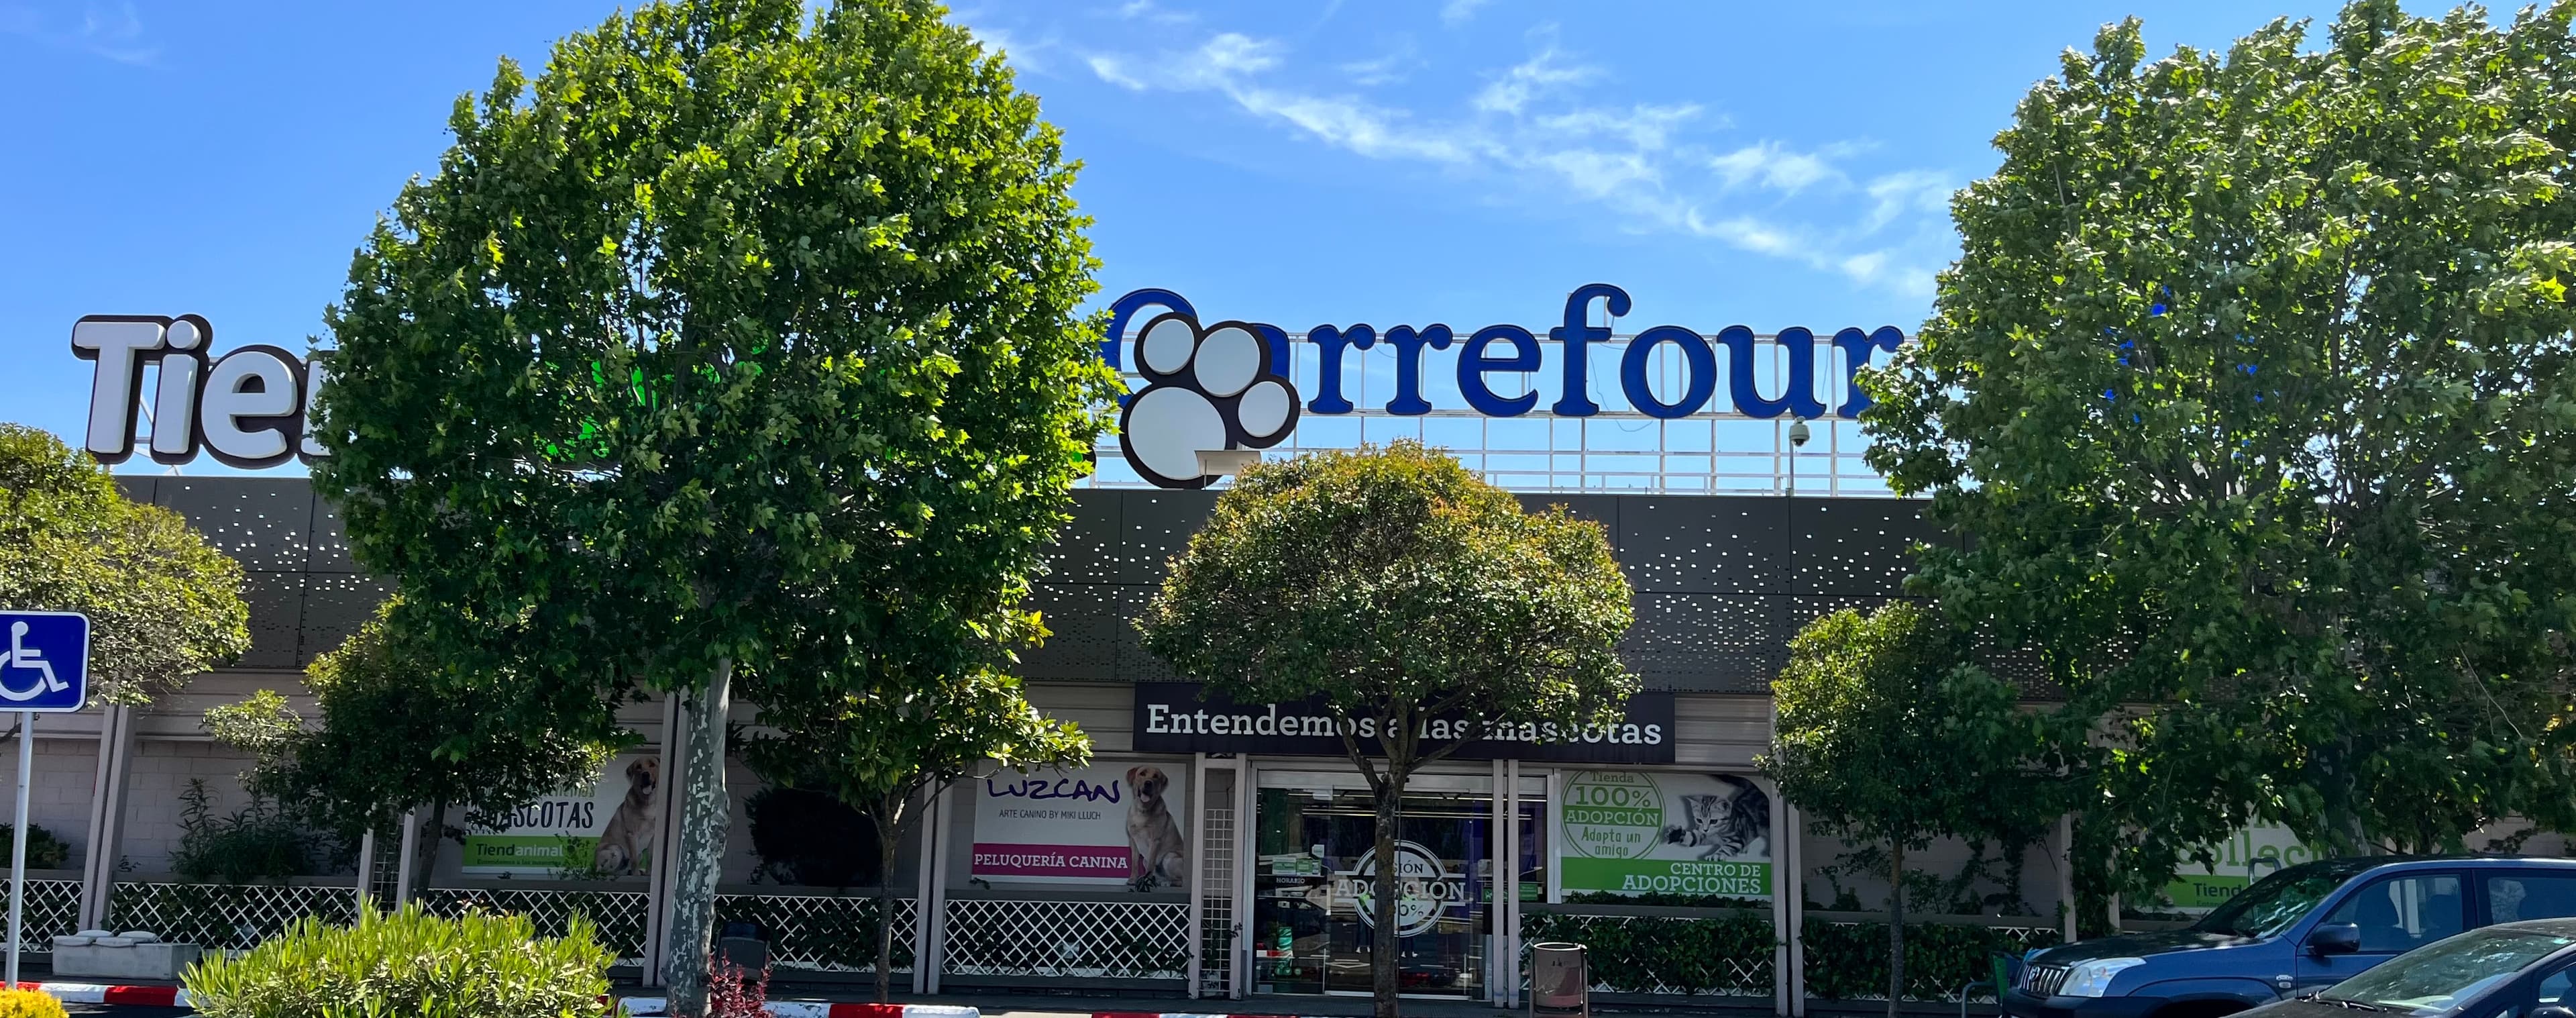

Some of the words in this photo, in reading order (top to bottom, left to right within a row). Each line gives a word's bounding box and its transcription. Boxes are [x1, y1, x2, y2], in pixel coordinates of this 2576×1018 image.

[1099, 283, 1904, 418] Crrefour
[70, 314, 334, 469] Tie
[1146, 703, 1376, 739] Entendemos
[1590, 771, 1634, 783] Tienda
[987, 778, 1120, 803] LUZCAN
[1576, 786, 1651, 807] 100%
[479, 801, 594, 829] ASCOTAS
[999, 809, 1018, 818] ARTE
[1020, 809, 1047, 819] CANINO
[1049, 810, 1059, 819] BY
[1061, 810, 1077, 819] MIKI
[1078, 811, 1101, 820] LLUCH
[1565, 808, 1659, 826] ADOPCIÓN
[1581, 826, 1621, 844] Adopta
[1626, 833, 1641, 843] un
[476, 844, 564, 857] Tiendanimal
[1595, 844, 1629, 859] amigo
[974, 852, 1066, 867] PELUQUERÍA
[1069, 856, 1128, 869] CANINA
[1670, 862, 1736, 876] CENTRO
[1740, 864, 1761, 877] DE
[1622, 874, 1761, 894] ADOPCIONES
[2193, 882, 2242, 897] Tiend
